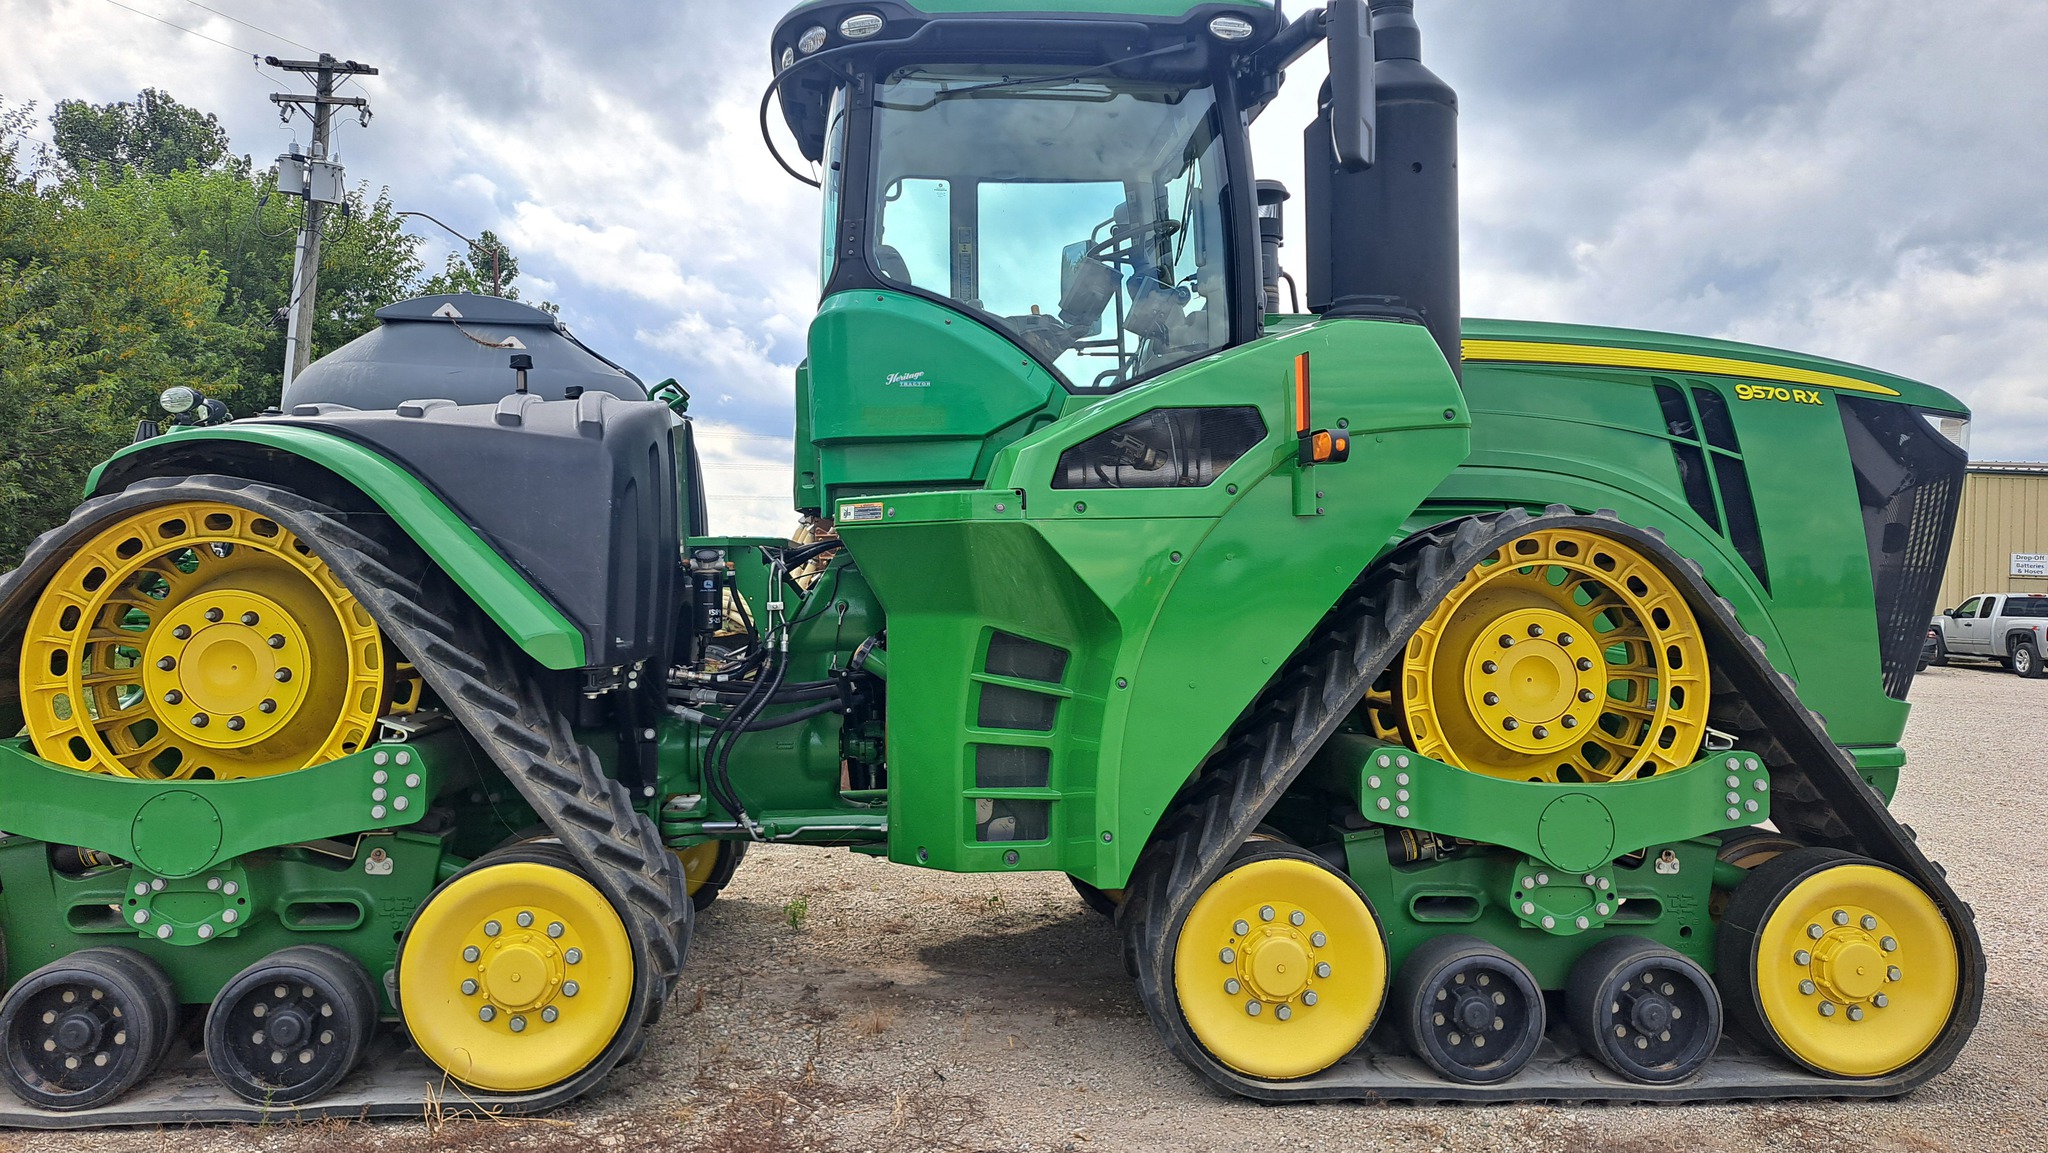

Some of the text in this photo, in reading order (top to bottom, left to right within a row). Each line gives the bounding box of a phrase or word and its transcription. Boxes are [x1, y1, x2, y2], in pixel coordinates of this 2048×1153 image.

[885, 371, 925, 385] Heritage
[1734, 383, 1824, 406] 9570 RX
